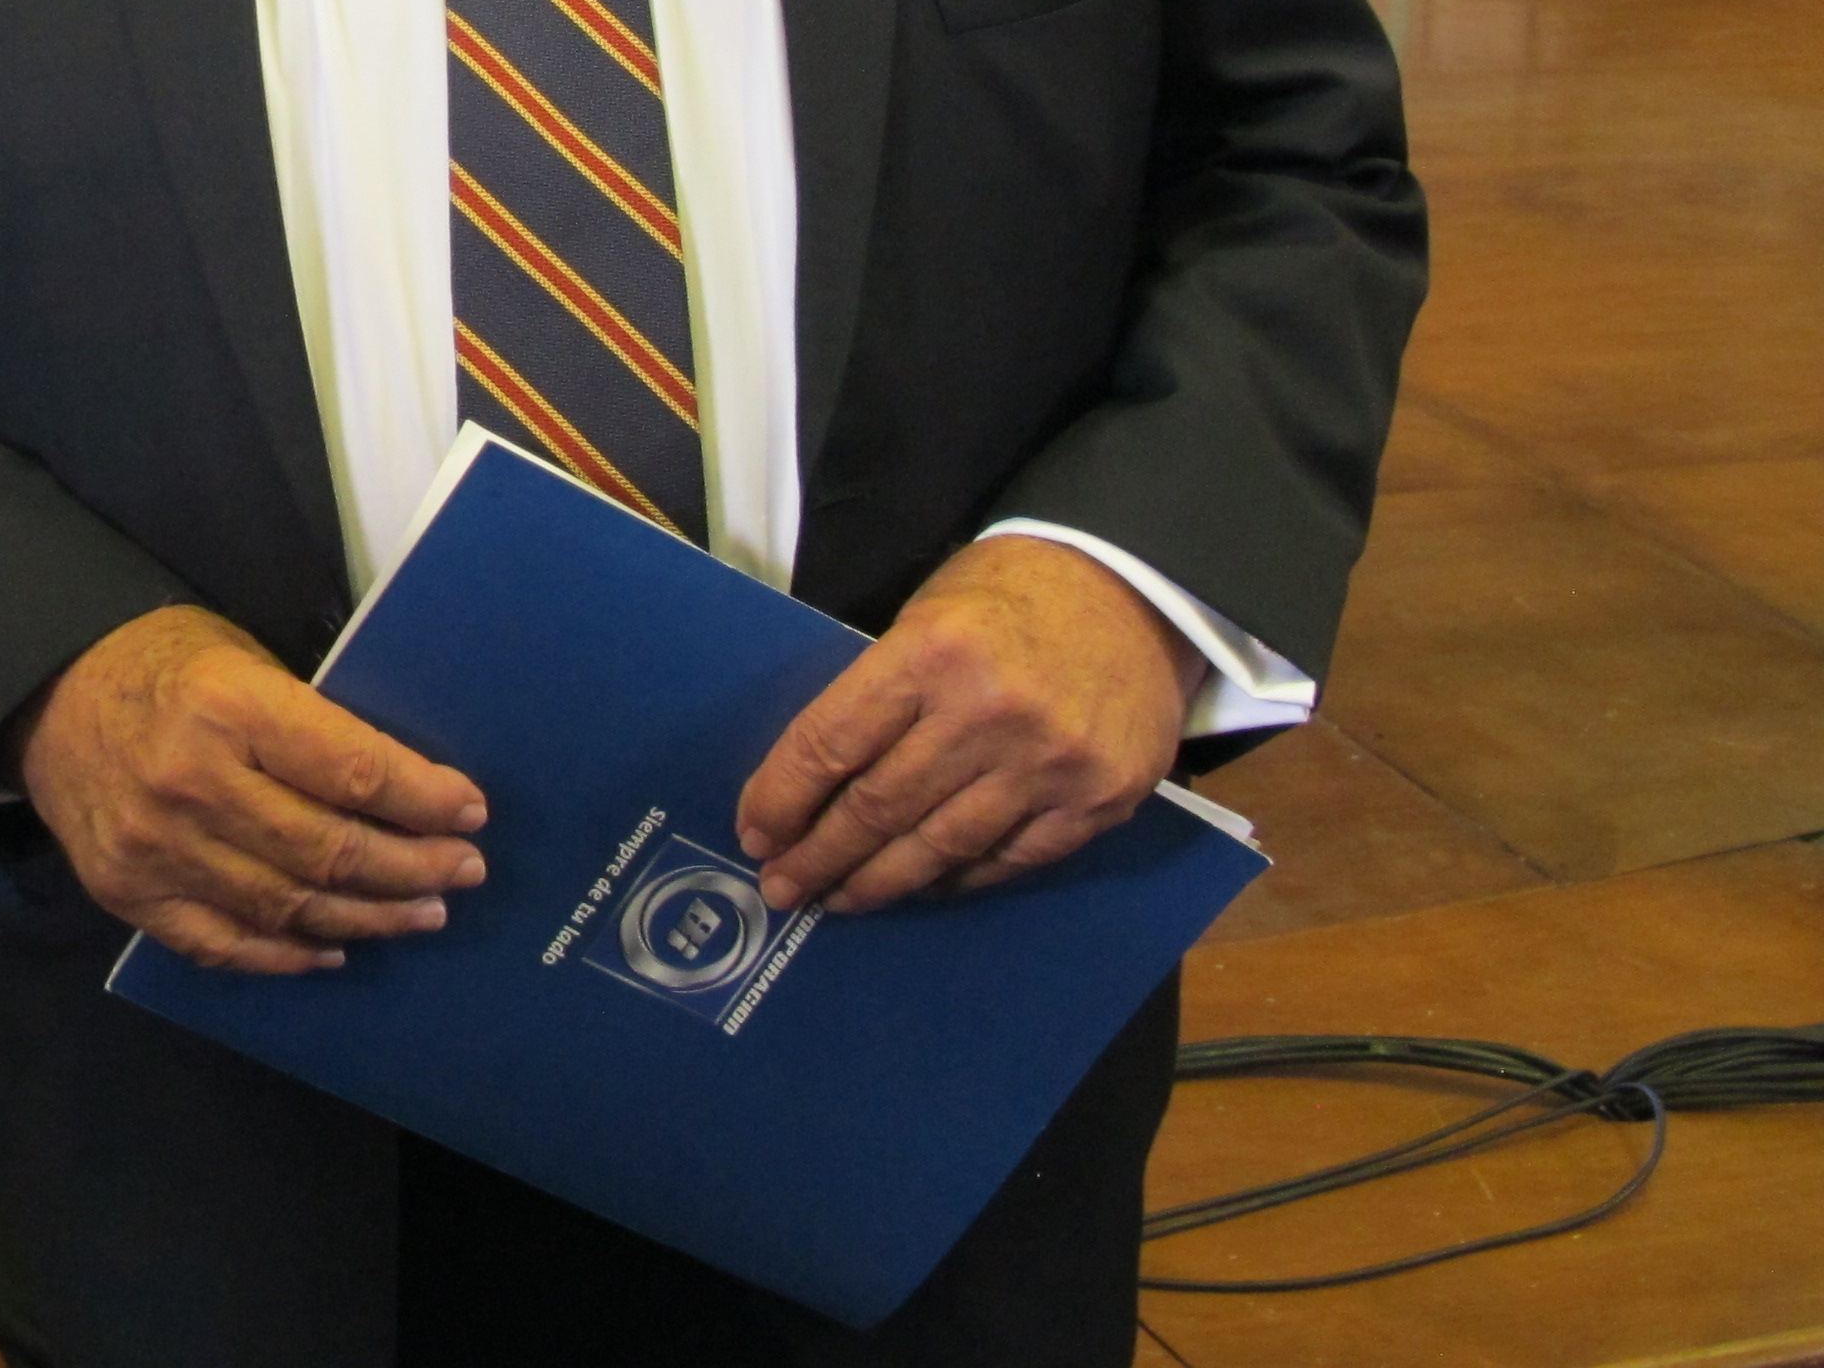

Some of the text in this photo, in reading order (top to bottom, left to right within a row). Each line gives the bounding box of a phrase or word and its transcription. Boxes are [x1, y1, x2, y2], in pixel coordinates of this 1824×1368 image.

[541, 805, 667, 966] Siempre de tu lado
